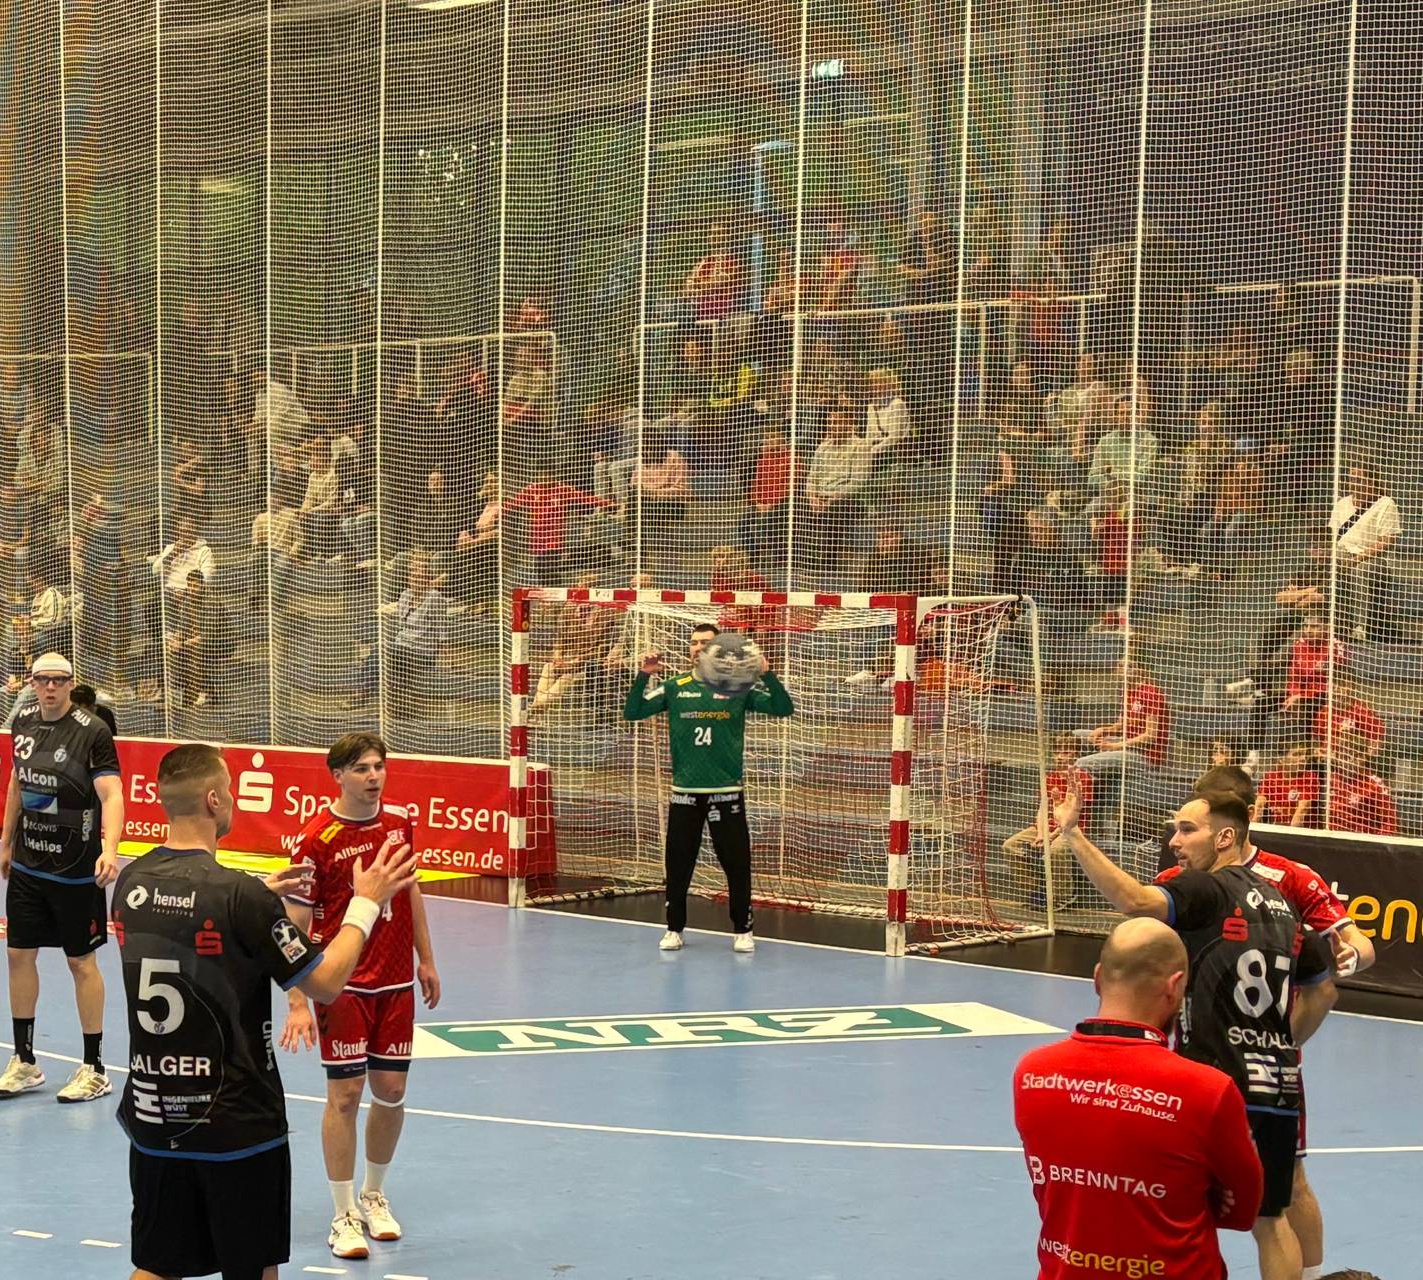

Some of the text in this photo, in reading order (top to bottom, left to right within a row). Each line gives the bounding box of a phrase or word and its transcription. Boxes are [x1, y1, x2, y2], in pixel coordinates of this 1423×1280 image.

[13, 734, 36, 760] 23
[694, 726, 713, 746] 24
[18, 766, 58, 787] Alcon
[428, 796, 509, 834] Essen
[334, 842, 373, 862] Allbau
[153, 887, 196, 909] hensel
[136, 957, 185, 1035] 5
[448, 1011, 943, 1049] NRZ
[1021, 1072, 1183, 1111] Stadtwerkessen
[1069, 1093, 1178, 1123] Wir sind Zuhause.
[1049, 1164, 1167, 1199] BRENNTAG
